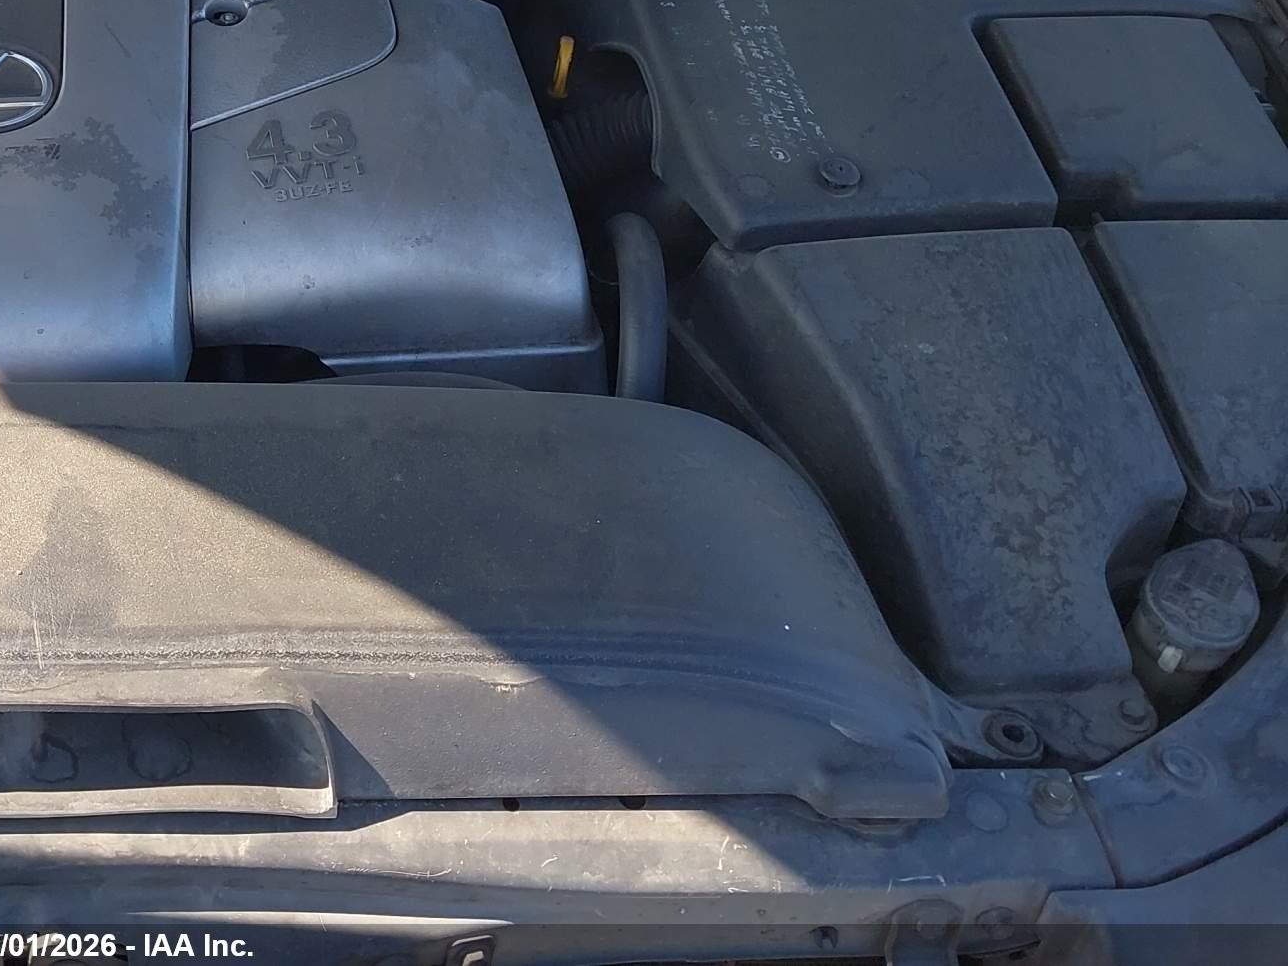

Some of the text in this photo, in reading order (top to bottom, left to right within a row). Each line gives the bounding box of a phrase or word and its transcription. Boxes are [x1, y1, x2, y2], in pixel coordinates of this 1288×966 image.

[245, 108, 358, 165] 4.3
[251, 155, 367, 190] VVT-i
[273, 180, 354, 203] 3UZ-FE
